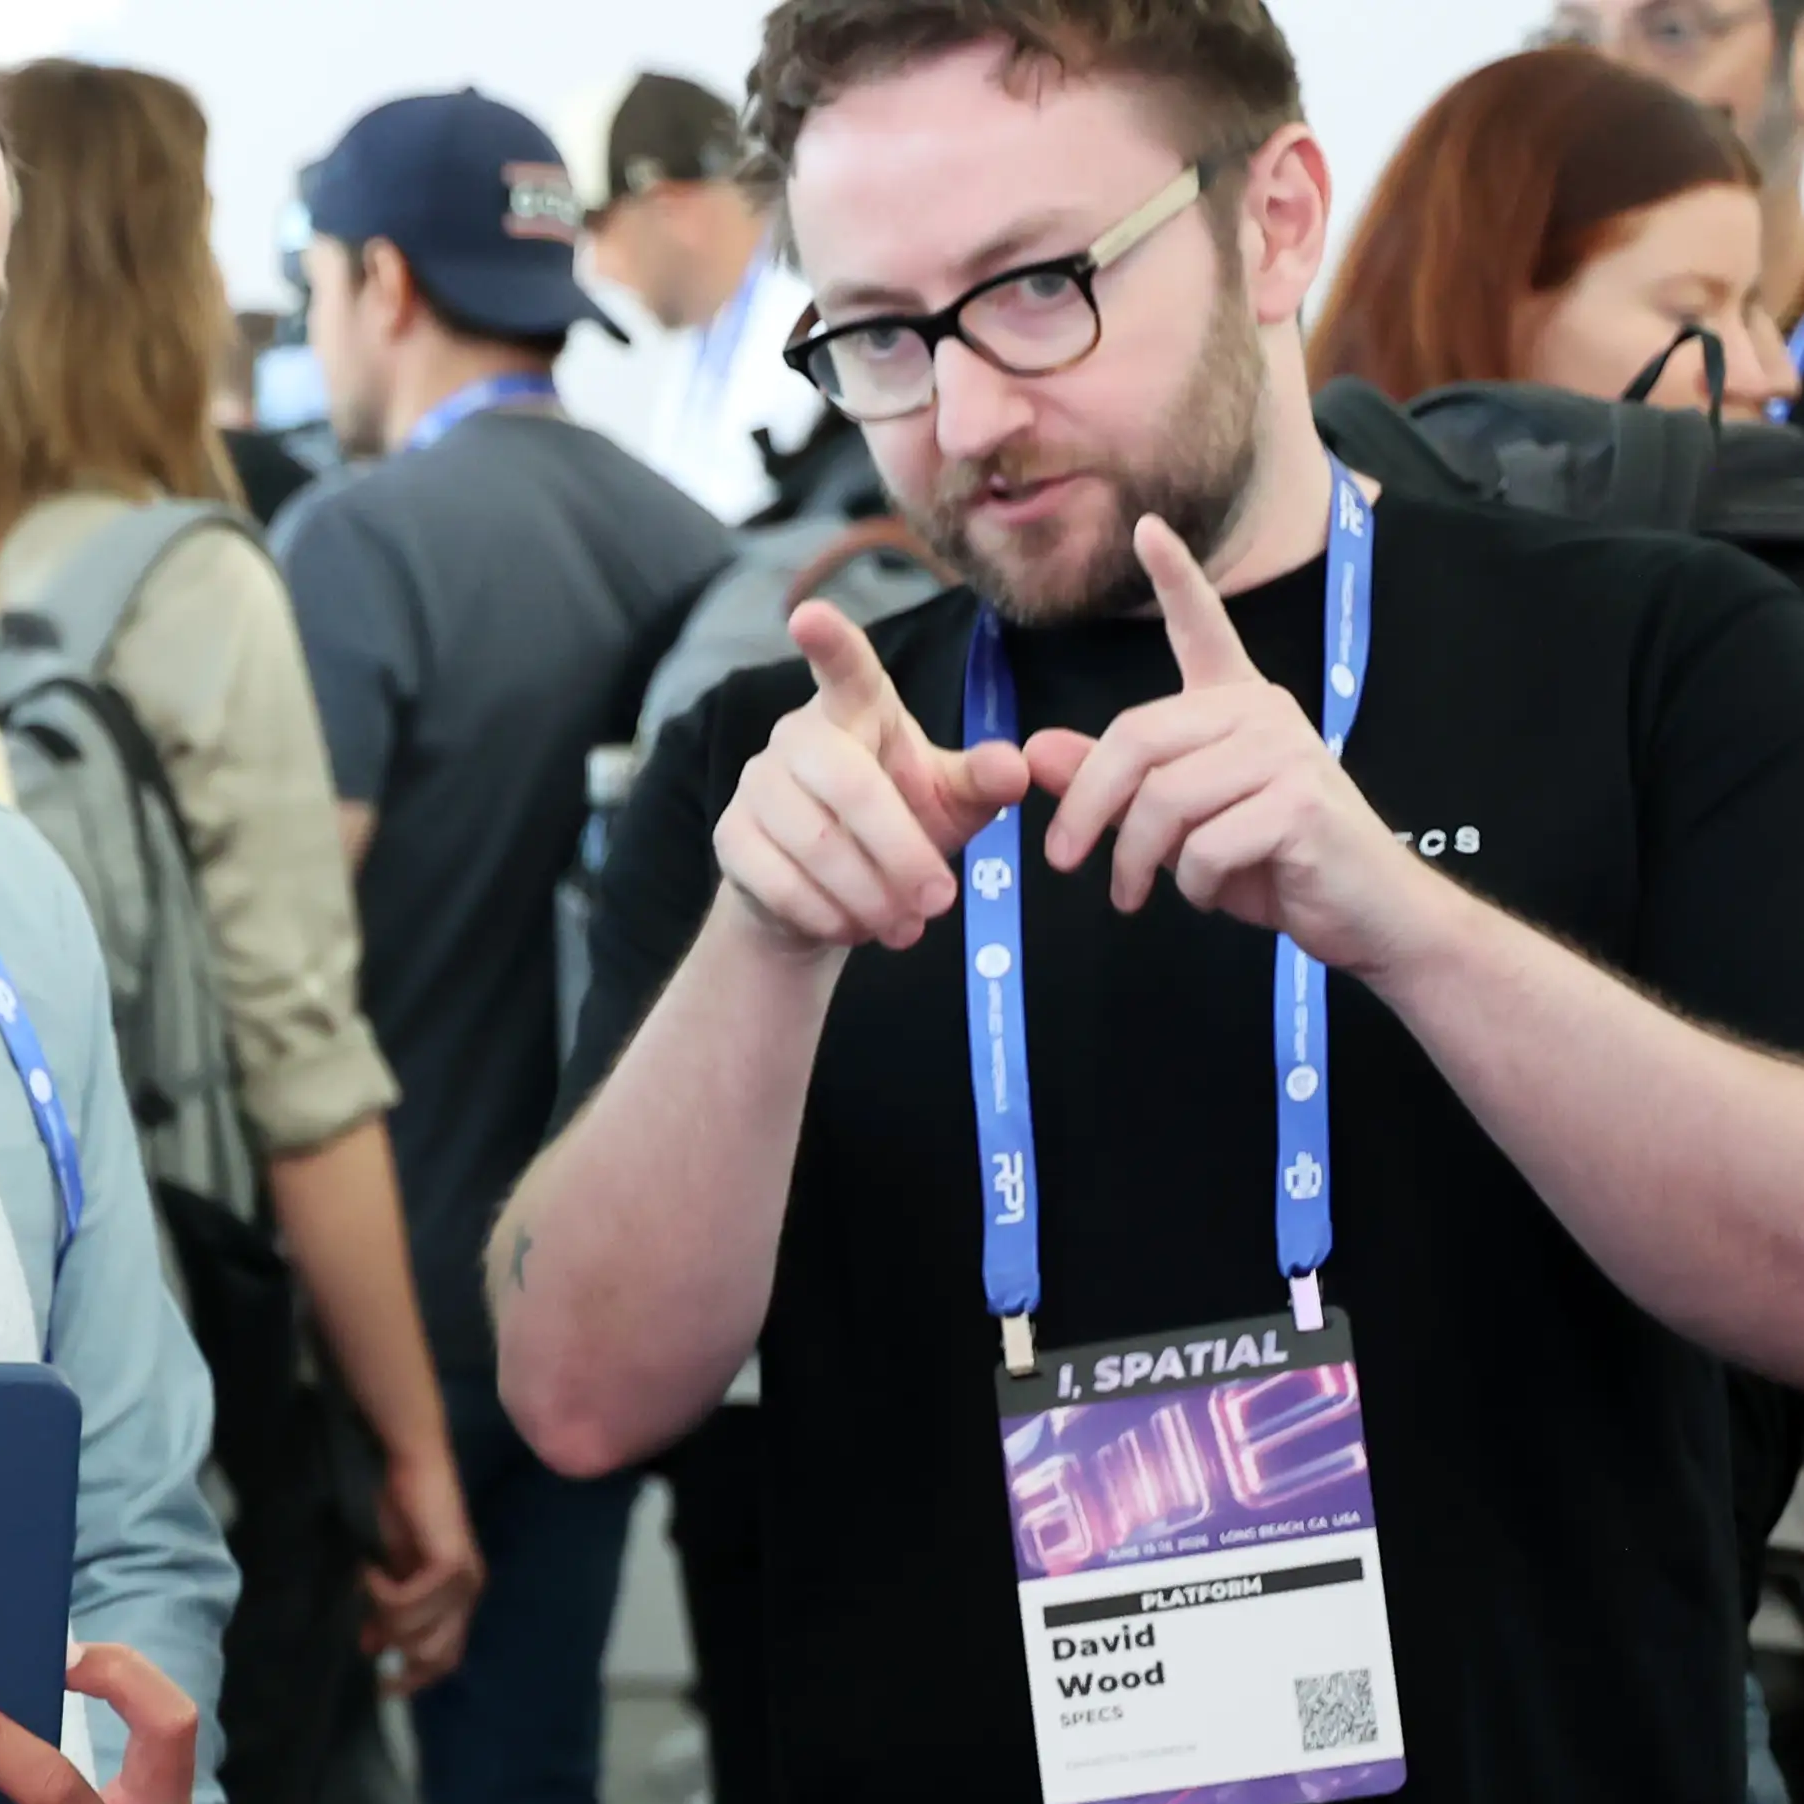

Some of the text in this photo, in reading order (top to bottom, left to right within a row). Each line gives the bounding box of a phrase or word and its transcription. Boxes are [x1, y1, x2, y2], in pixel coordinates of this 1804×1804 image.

[1057, 1329, 1289, 1400] I, SPATIAL
[1141, 1575, 1263, 1612] PLATFORM
[1052, 1623, 1155, 1661] David
[1057, 1661, 1165, 1699] Wood
[1060, 1704, 1123, 1729] SPECS
